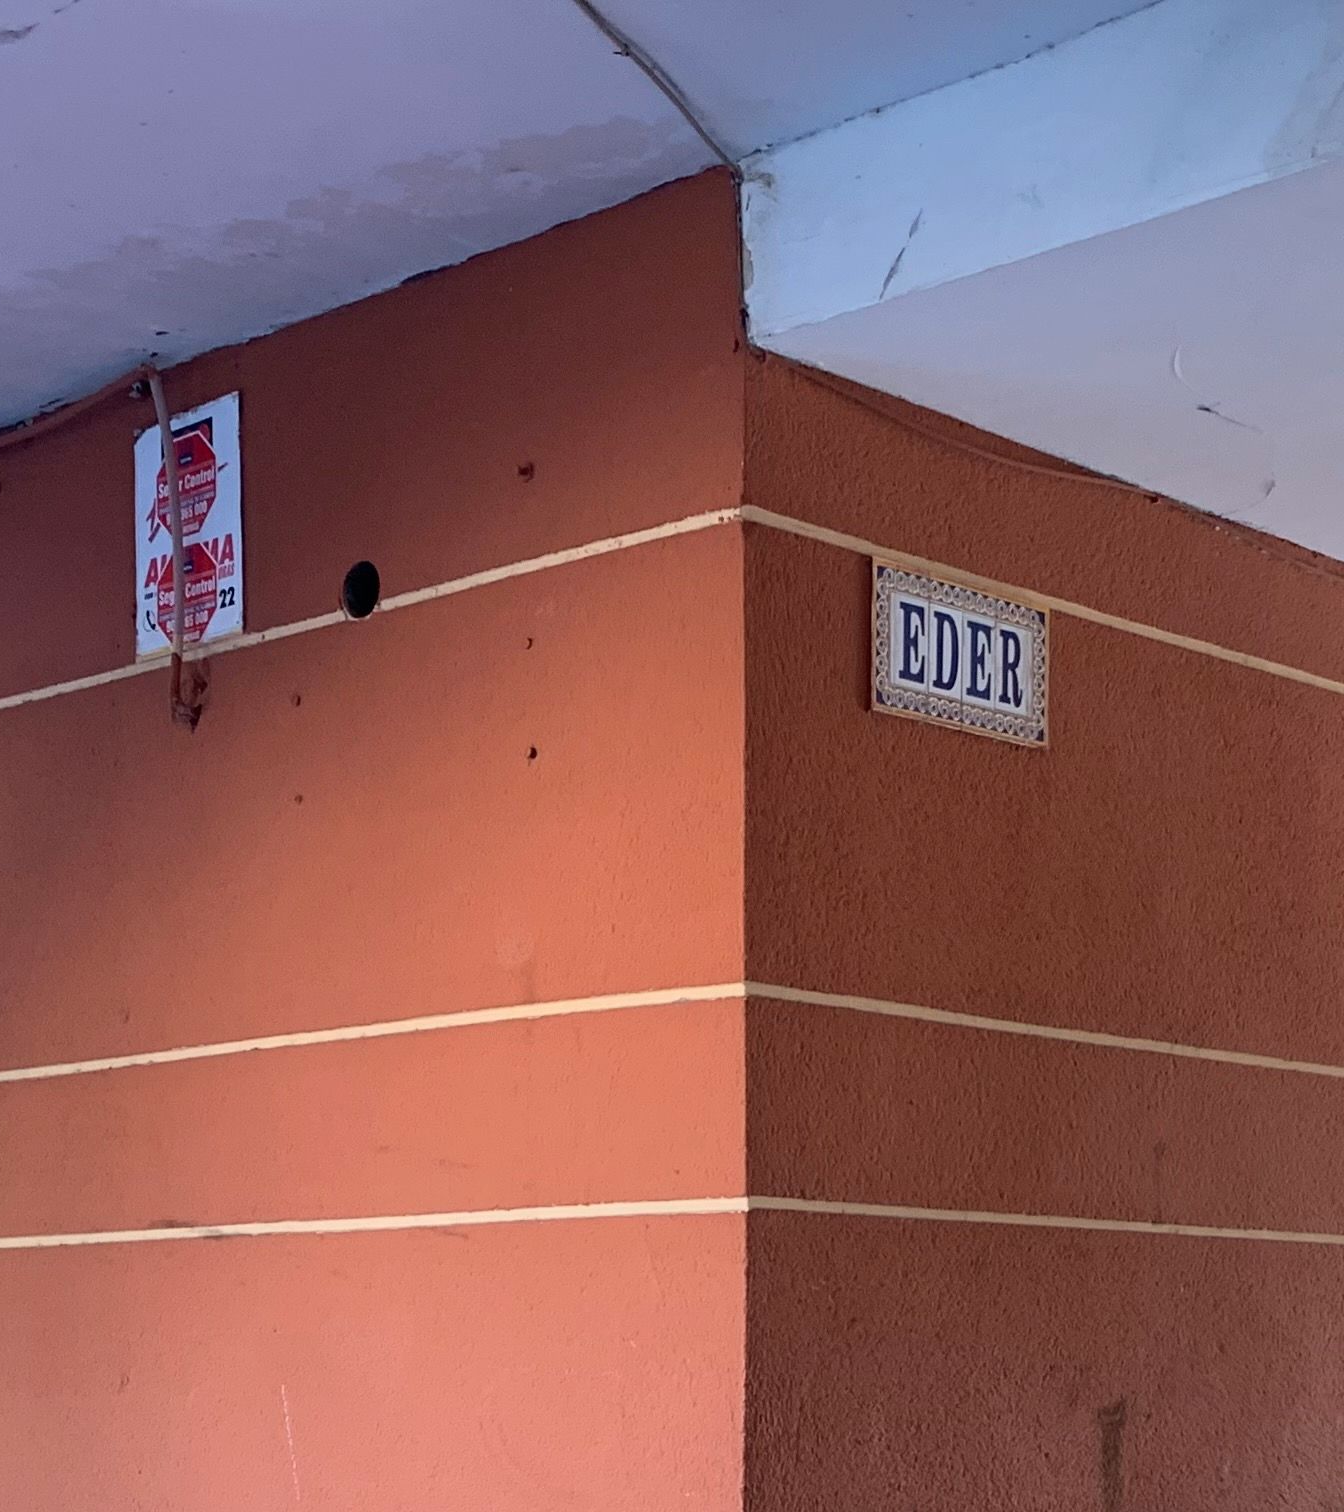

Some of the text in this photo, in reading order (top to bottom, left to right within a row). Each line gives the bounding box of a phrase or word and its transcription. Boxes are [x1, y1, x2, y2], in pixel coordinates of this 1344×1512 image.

[184, 466, 215, 489] Control
[184, 575, 216, 599] Control
[898, 600, 1024, 709] EDER
